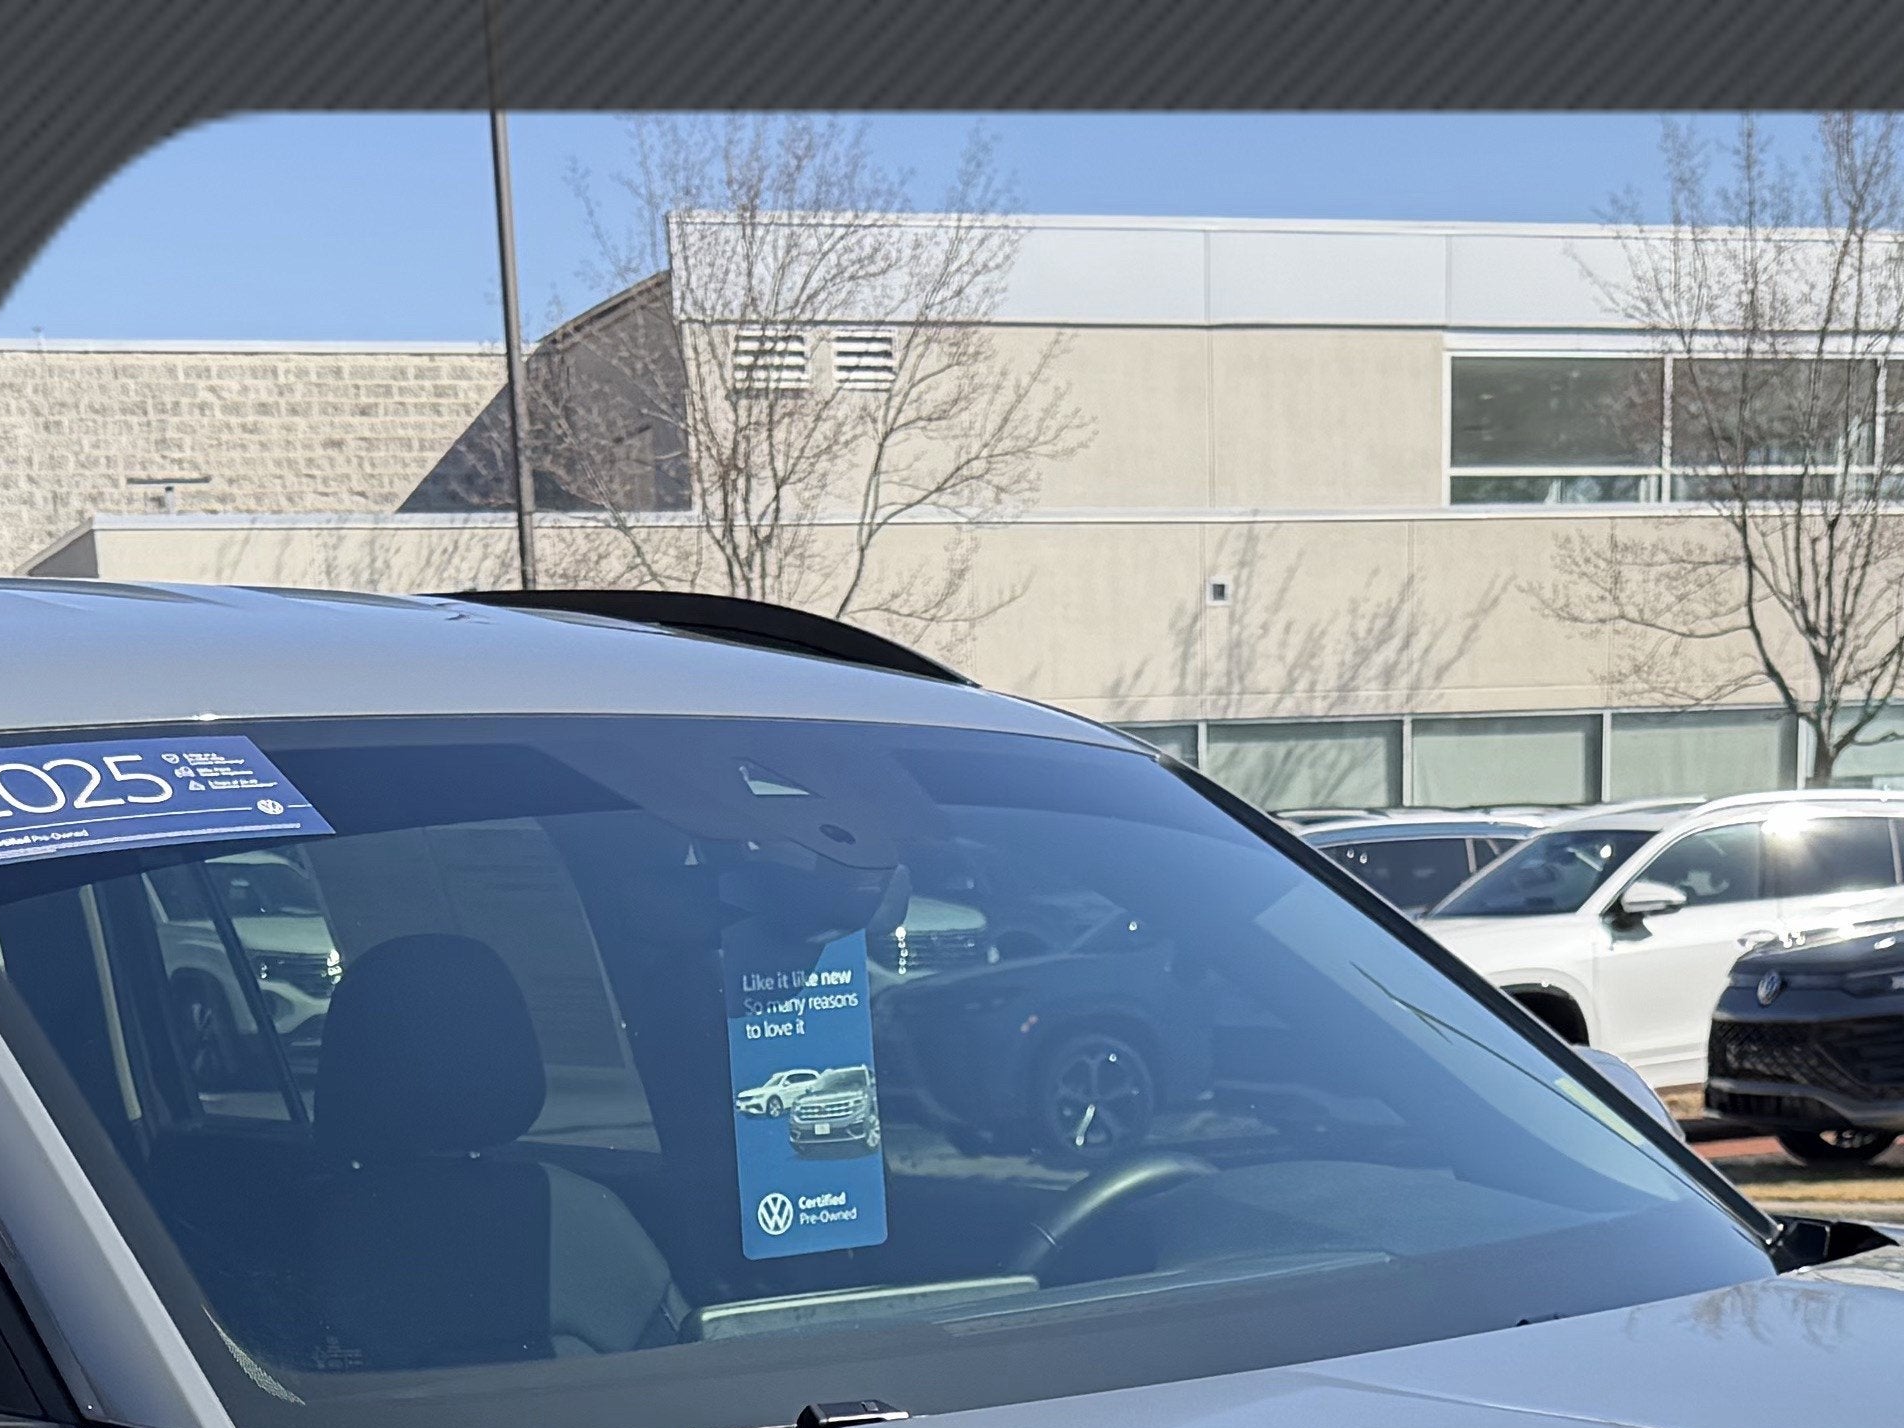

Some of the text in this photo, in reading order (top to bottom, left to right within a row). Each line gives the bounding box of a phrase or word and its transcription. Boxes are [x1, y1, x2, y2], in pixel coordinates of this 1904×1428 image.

[741, 973, 775, 993] Like
[777, 971, 789, 990] it
[821, 970, 852, 986] new
[743, 992, 859, 1016] So many reasons
[745, 1018, 806, 1040] to love it
[798, 1191, 846, 1209] Certified
[799, 1207, 857, 1225] Pre-Owned
